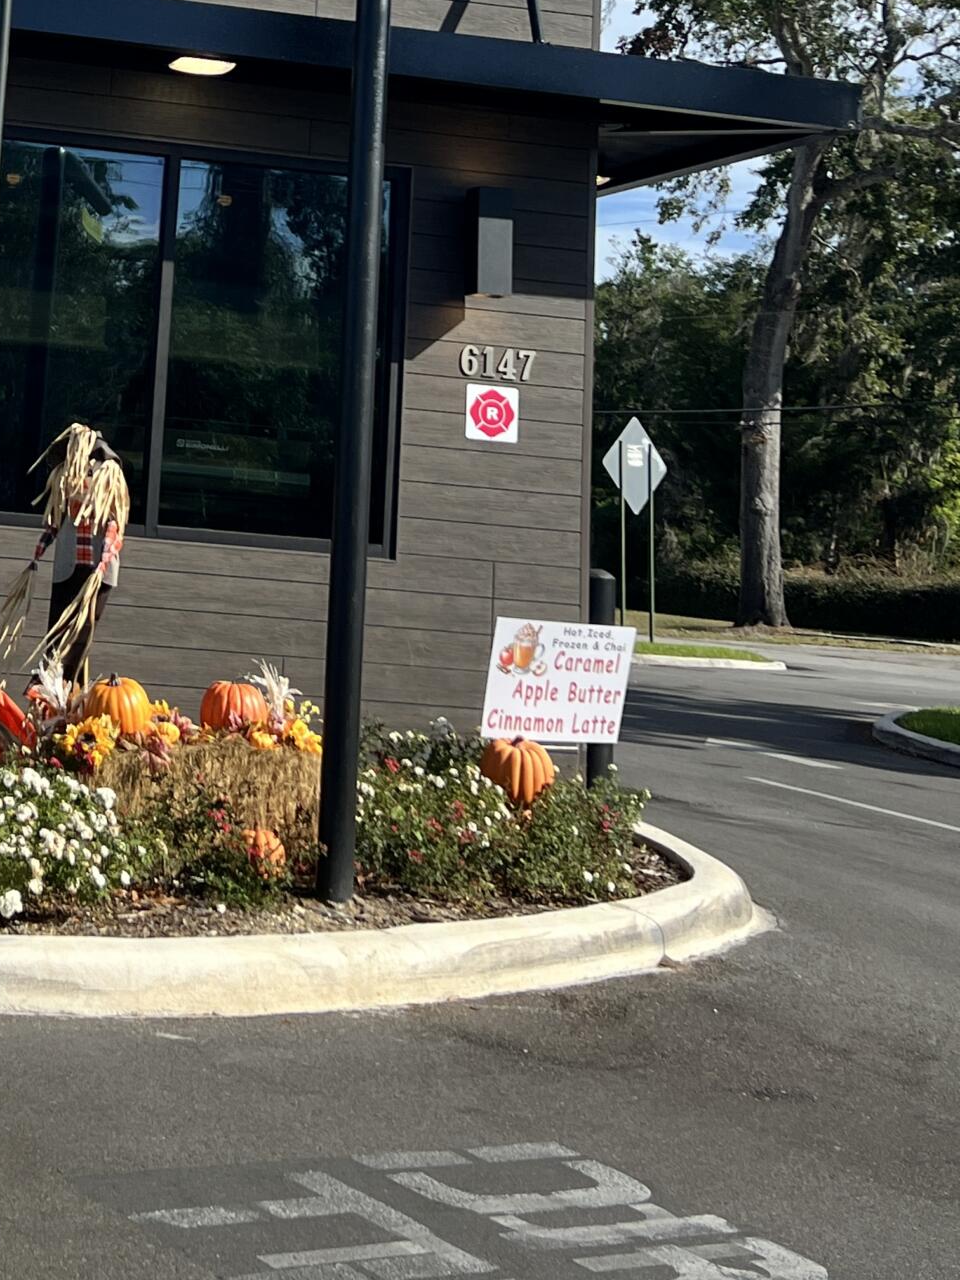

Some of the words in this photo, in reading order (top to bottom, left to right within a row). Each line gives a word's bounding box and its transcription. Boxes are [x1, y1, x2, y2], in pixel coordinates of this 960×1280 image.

[460, 344, 537, 381] 6147
[486, 406, 499, 420] R
[552, 639, 589, 650] Frozen
[593, 641, 600, 651] &
[603, 642, 627, 652] Chai
[554, 650, 621, 674] Caramel
[512, 679, 559, 707] Apple
[567, 681, 622, 705] Butter
[487, 708, 564, 733] Cinnamon
[571, 713, 616, 735] Latte
